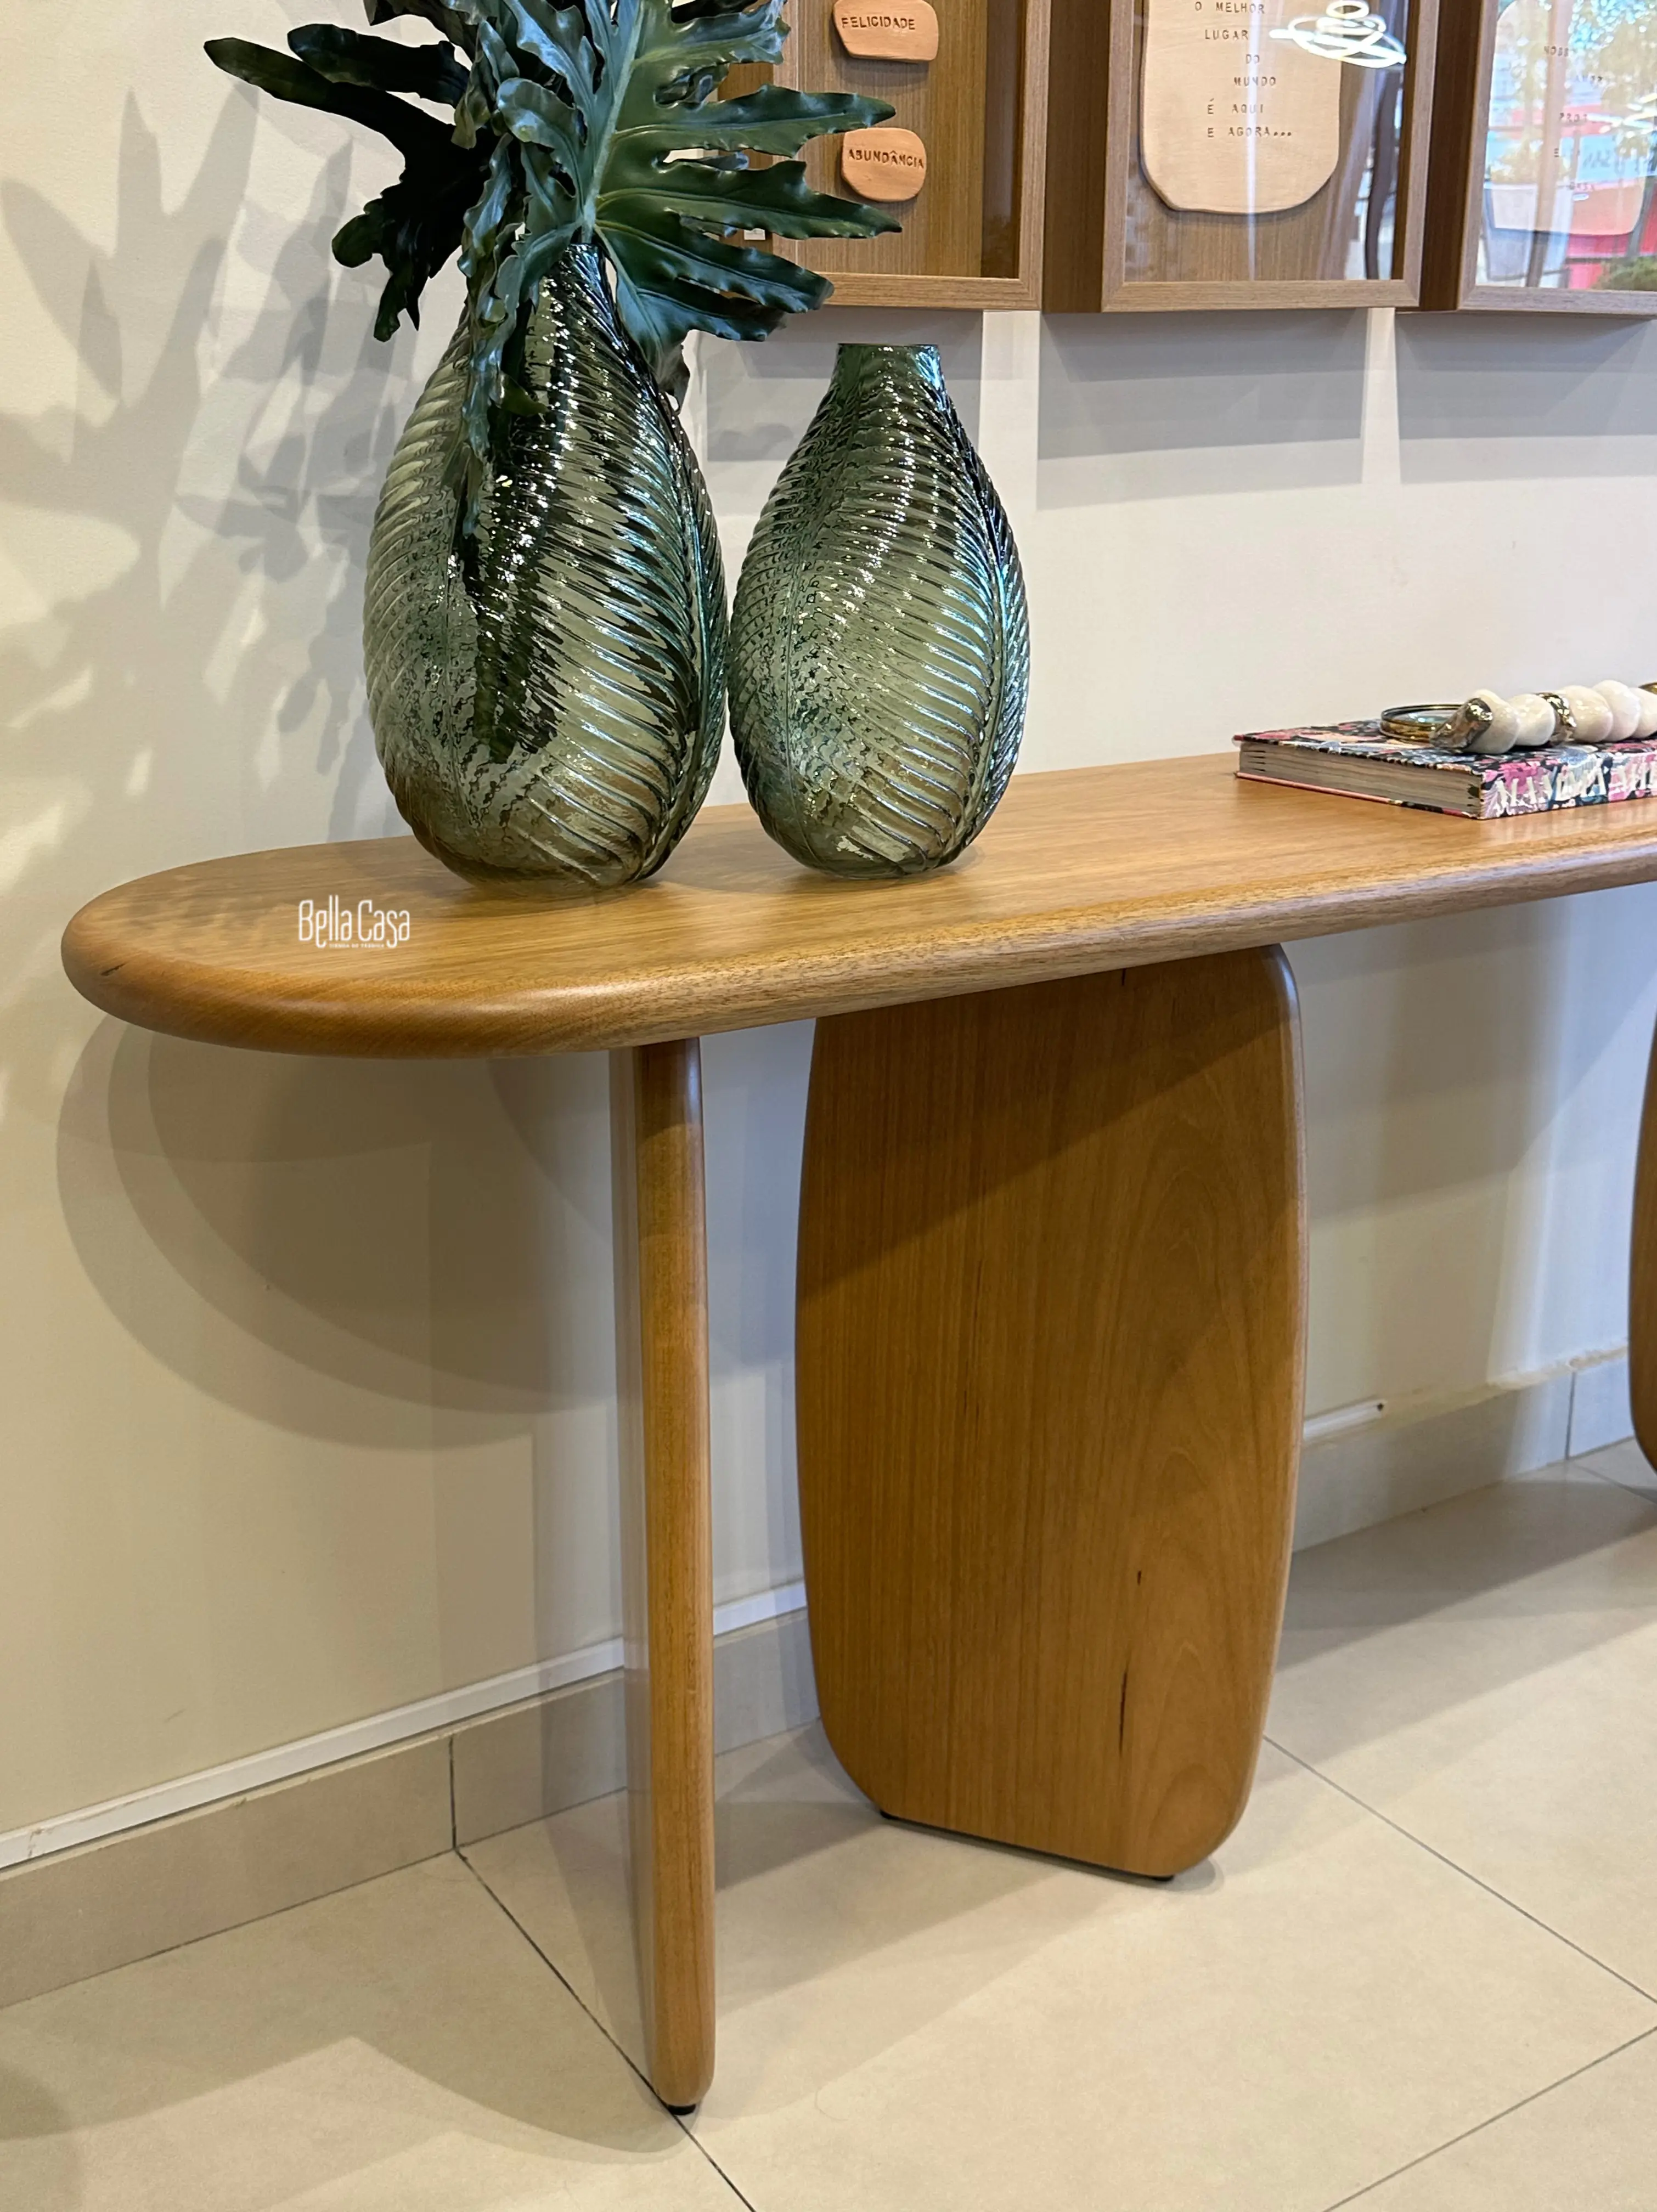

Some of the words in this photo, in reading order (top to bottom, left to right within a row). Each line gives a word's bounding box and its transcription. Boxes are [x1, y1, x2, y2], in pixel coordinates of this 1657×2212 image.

[1195, 1, 1202, 11] O
[1216, 2, 1265, 14] MELHOR
[841, 16, 916, 30] FELICIDADE
[1204, 29, 1249, 40] LUGAR
[1245, 54, 1260, 64] DO
[1234, 76, 1277, 87] MUNDO
[1207, 98, 1214, 115] É
[1232, 104, 1264, 114] AQUI
[1207, 127, 1214, 138] E
[1228, 127, 1292, 137] AGORA...
[848, 148, 924, 169] ABUNDÂNCIA
